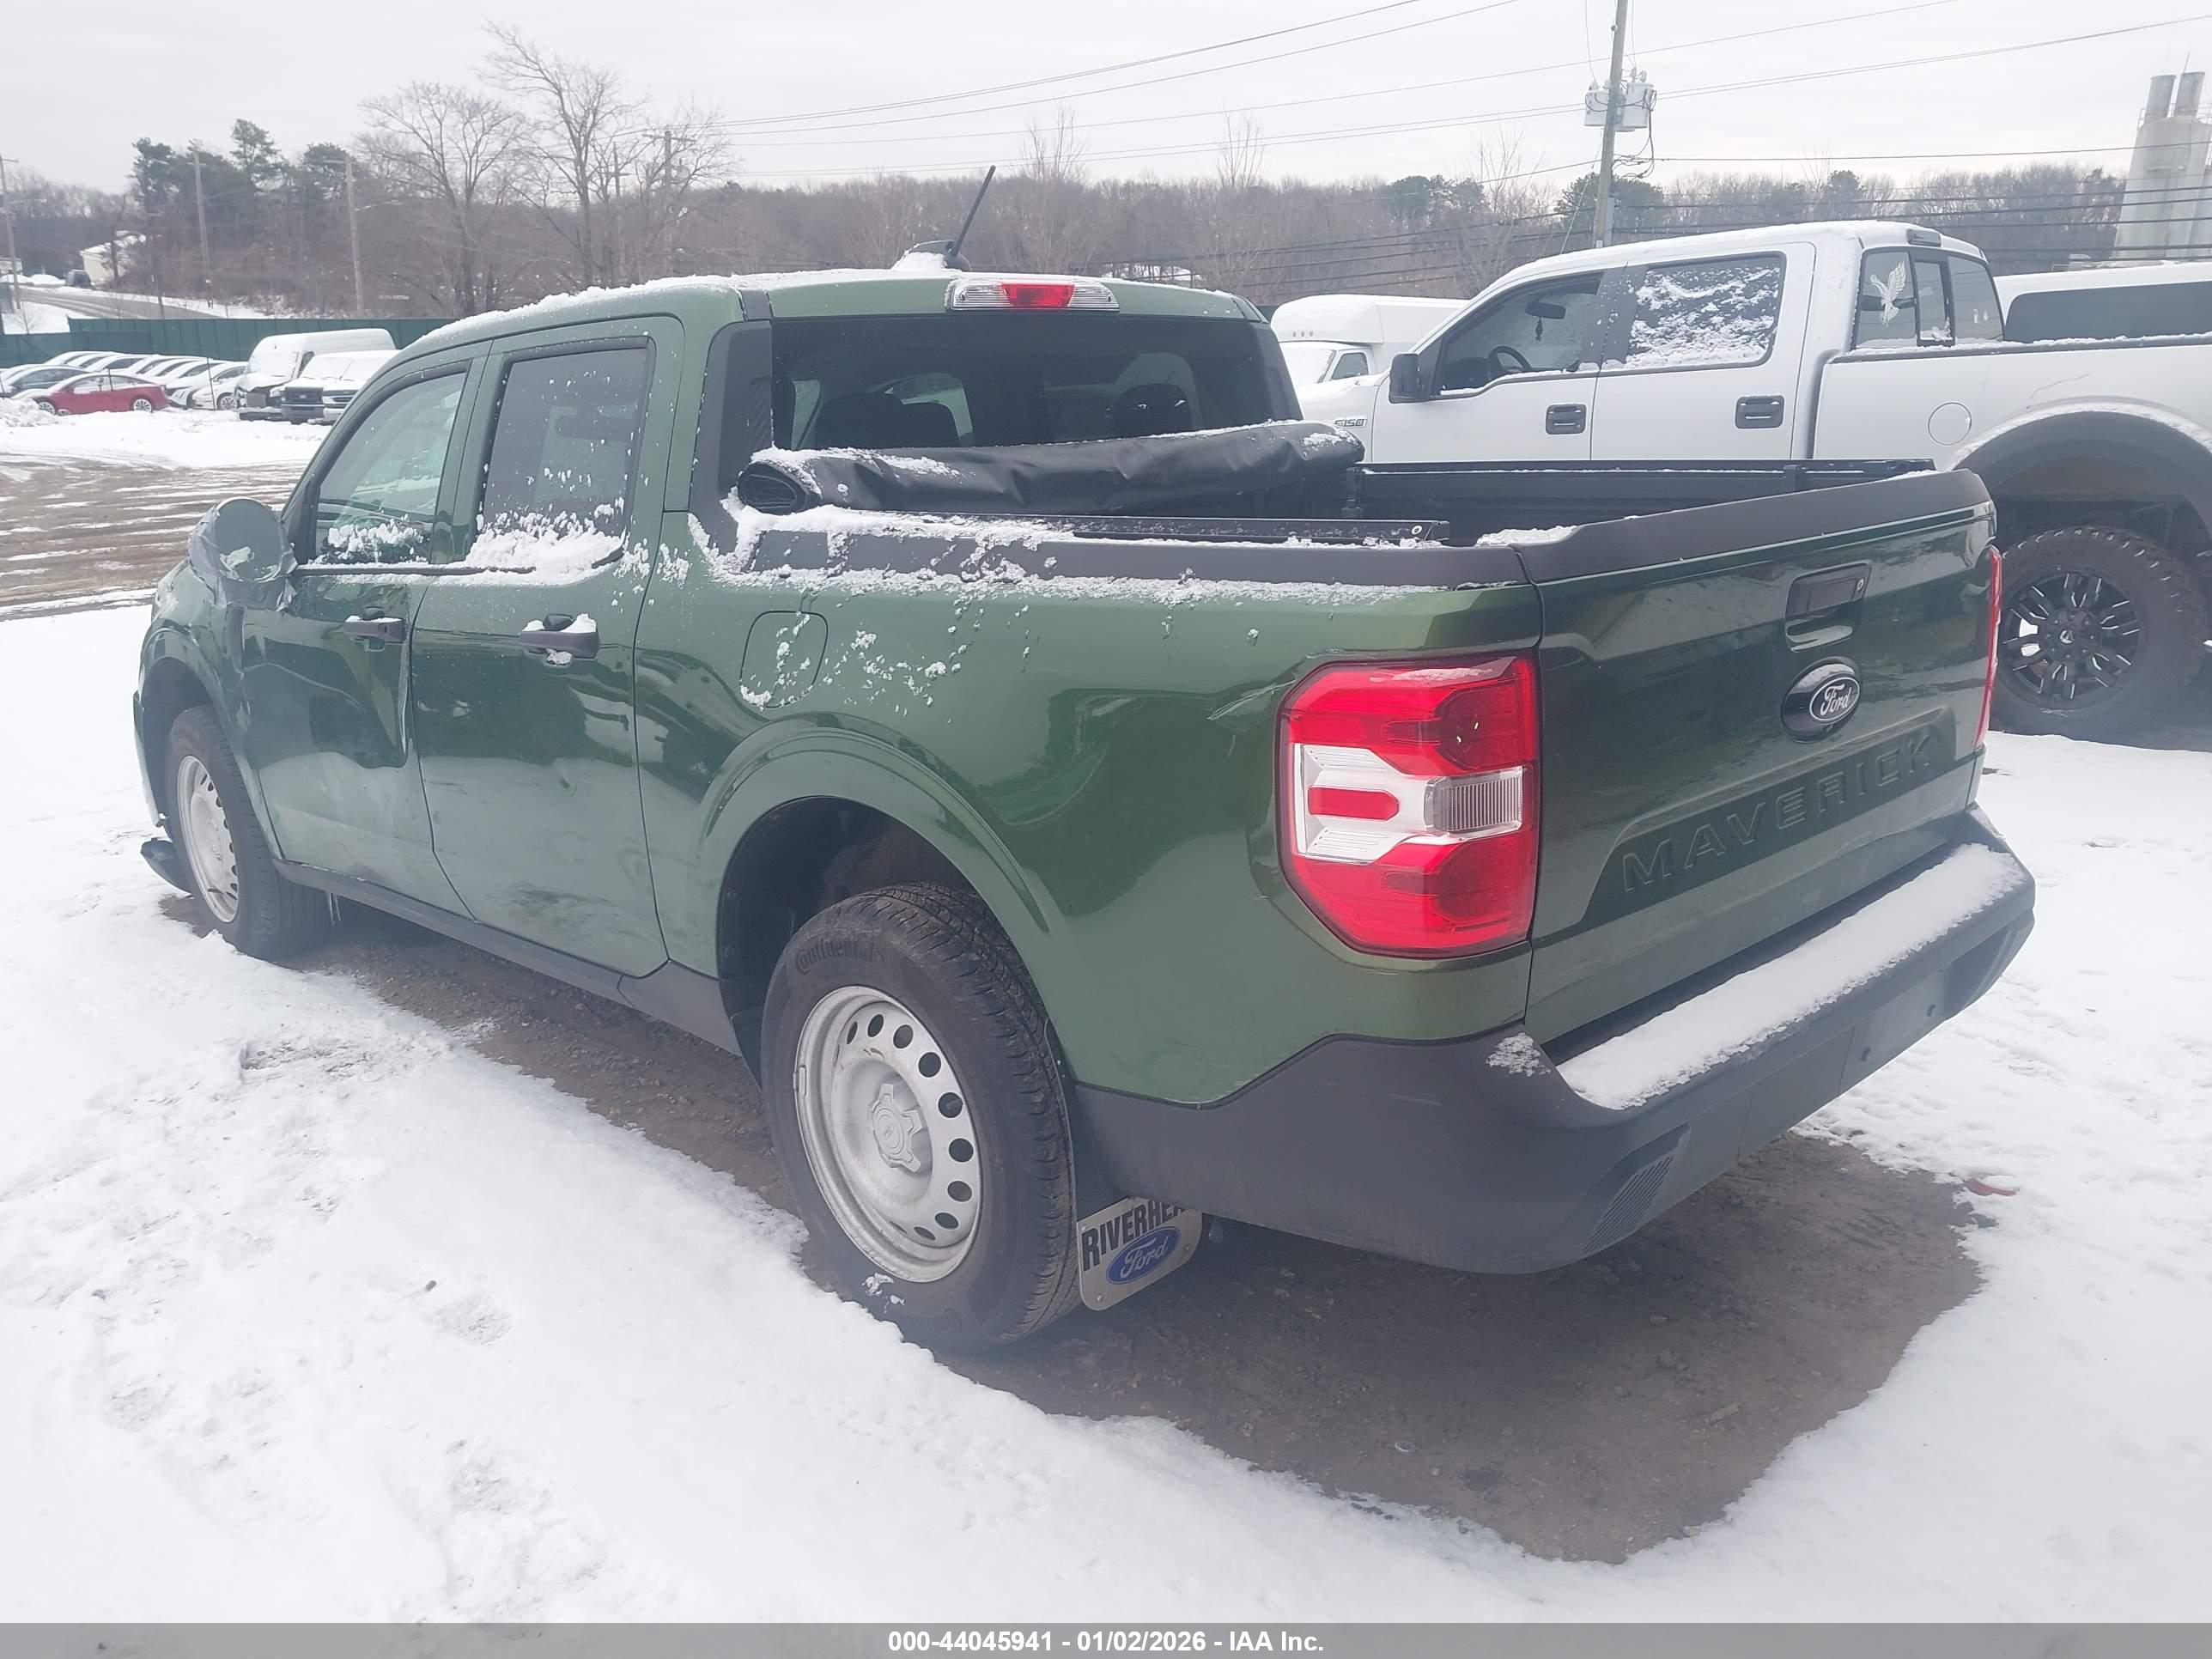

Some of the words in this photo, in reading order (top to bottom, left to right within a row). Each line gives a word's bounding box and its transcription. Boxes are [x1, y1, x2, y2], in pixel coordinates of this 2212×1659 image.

[1820, 684, 1852, 716] Ford
[1622, 734, 1931, 893] MAVERICK
[1119, 1237, 1170, 1279] Ford
